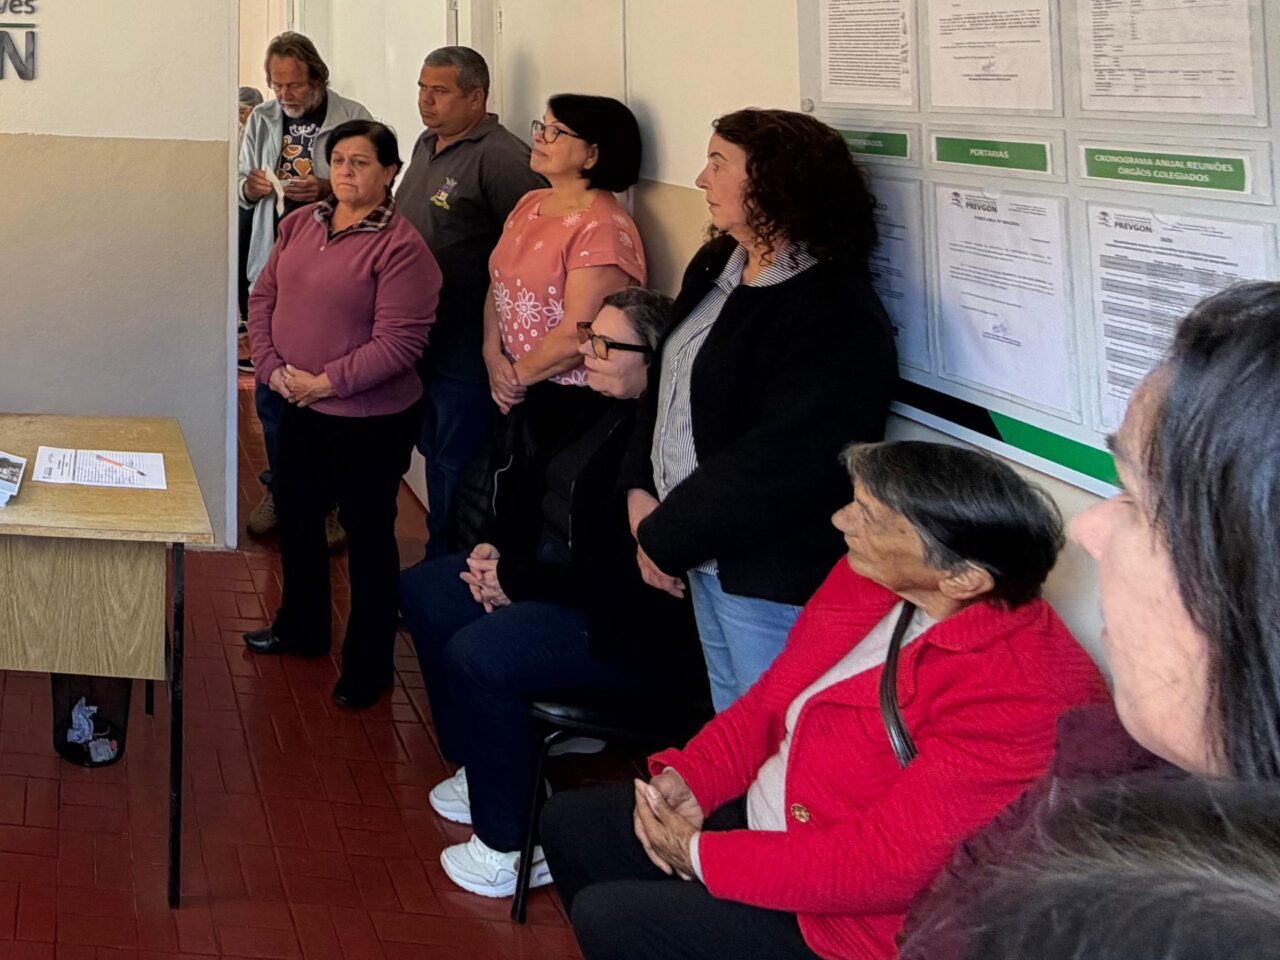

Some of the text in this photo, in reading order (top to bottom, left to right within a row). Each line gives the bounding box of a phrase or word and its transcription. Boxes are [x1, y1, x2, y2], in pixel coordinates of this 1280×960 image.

[969, 148, 1009, 159] PORTARIAS
[1094, 154, 1235, 173] CRONOGRAMA ANUAL REUNIÕES
[1153, 170, 1210, 183] COLEGIADOS
[965, 202, 998, 213] PREVGON
[1114, 221, 1153, 234] PREVGON
